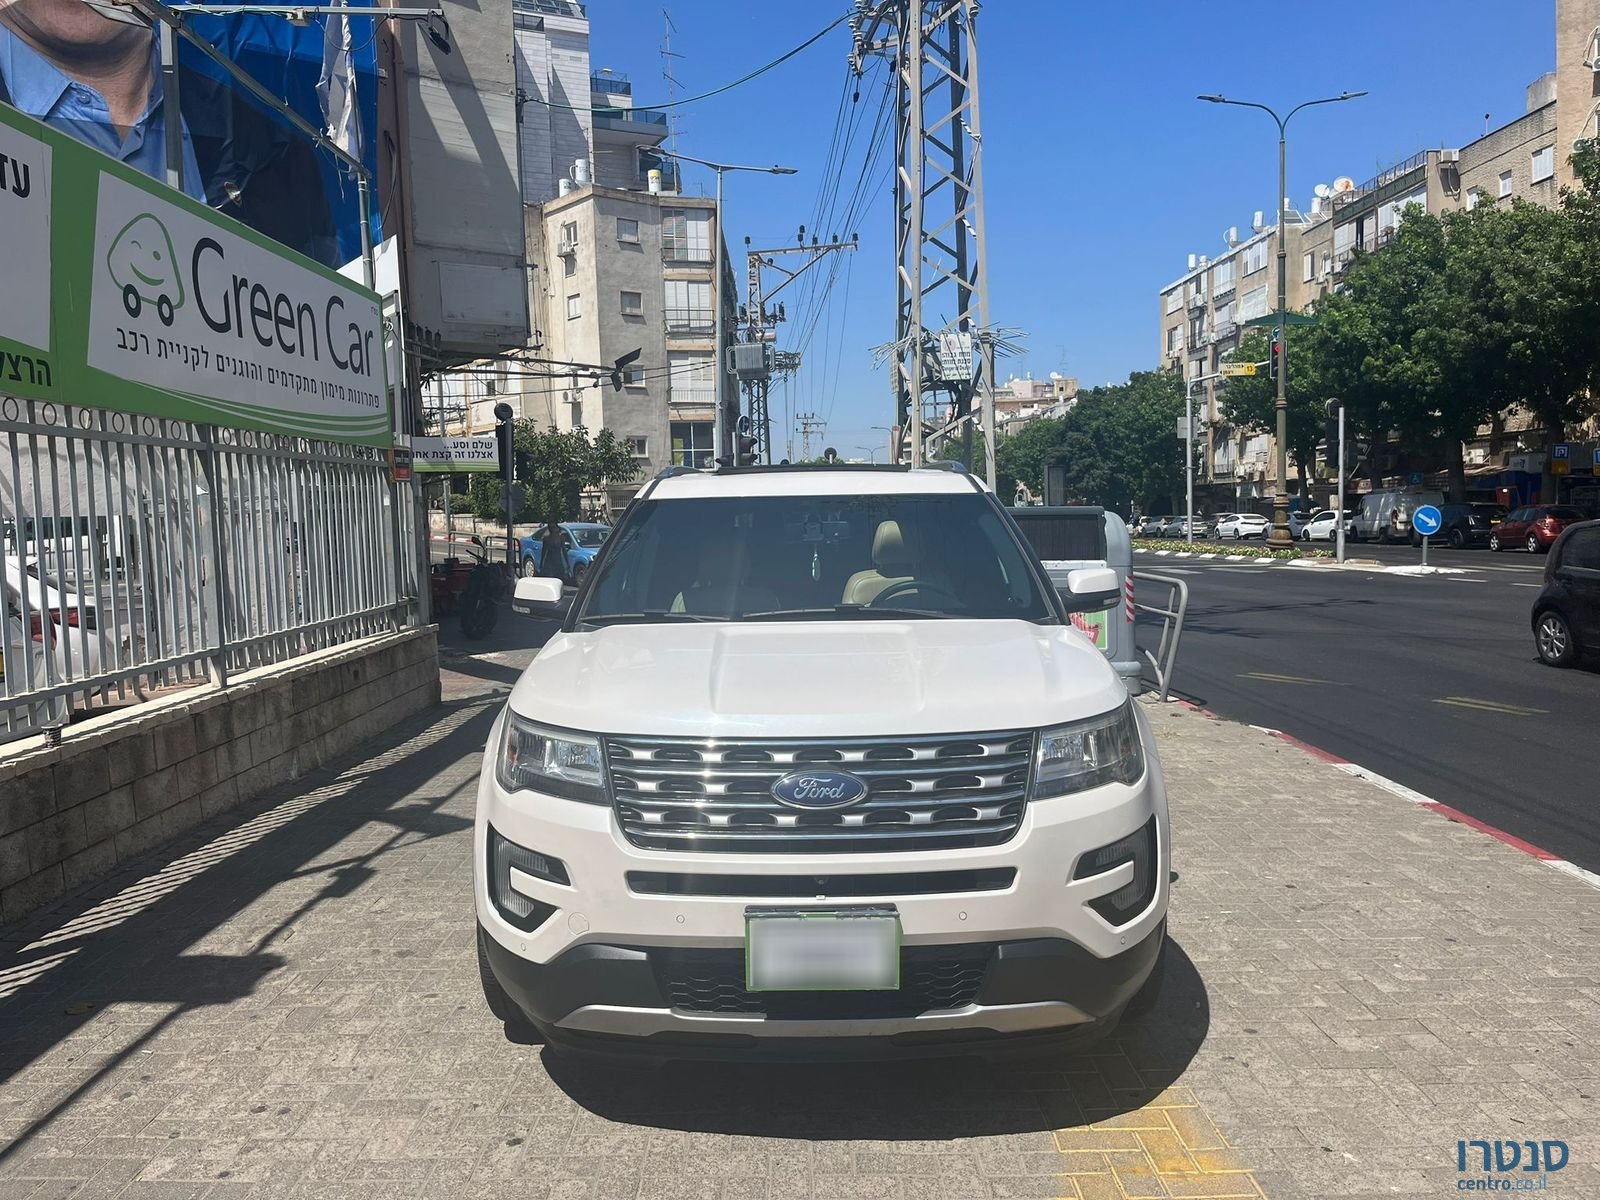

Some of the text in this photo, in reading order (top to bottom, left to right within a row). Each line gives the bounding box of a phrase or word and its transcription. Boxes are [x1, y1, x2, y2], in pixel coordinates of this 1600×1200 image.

[192, 237, 374, 377] Green Car
[117, 328, 379, 408] פתרונות מימון מתקדמים והוגנים לקניית רכב
[472, 440, 493, 449] שלם
[431, 451, 452, 461] קצת
[454, 451, 465, 459] זה
[467, 450, 493, 459] אצלנו
[793, 777, 846, 799] Ford
